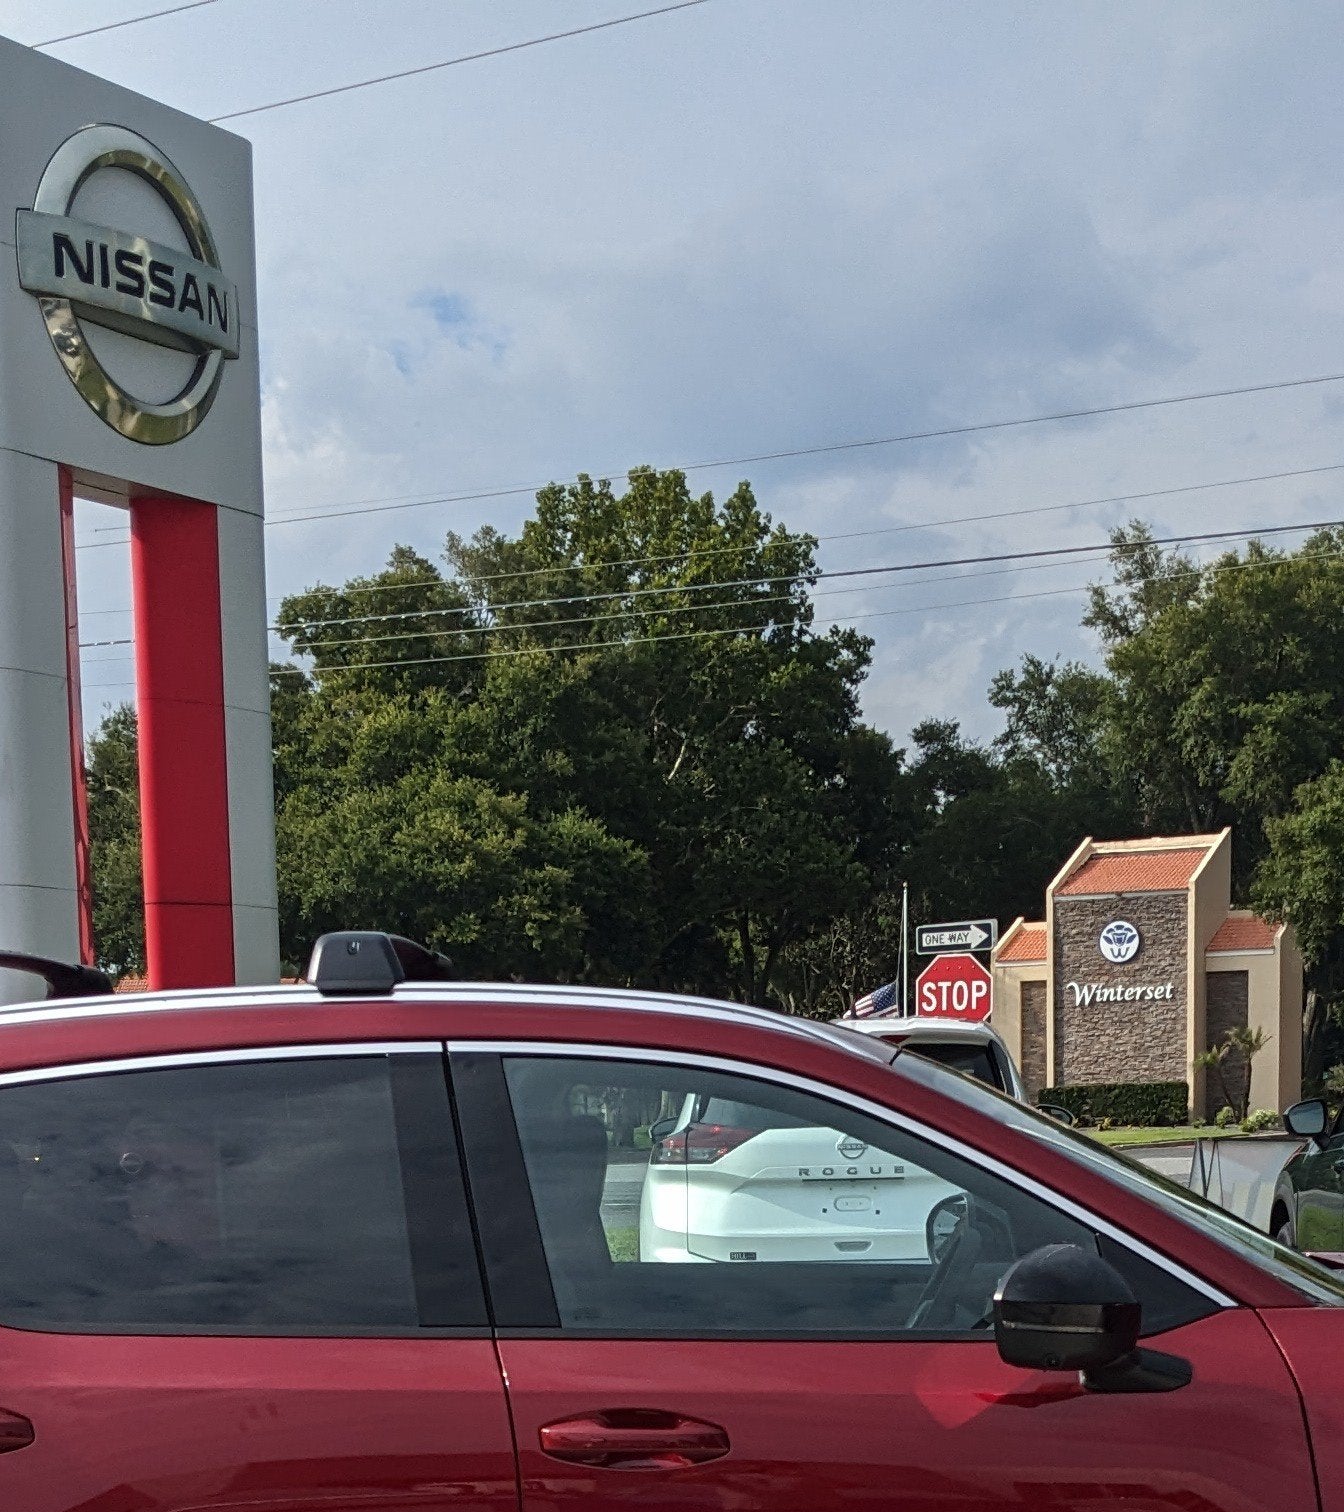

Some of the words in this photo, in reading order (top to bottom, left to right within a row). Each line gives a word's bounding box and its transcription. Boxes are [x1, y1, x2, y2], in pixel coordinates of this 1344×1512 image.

[52, 232, 230, 334] NISSAN
[924, 933, 945, 945] ONE
[948, 932, 970, 943] WAY
[921, 980, 988, 1012] STOP
[1066, 981, 1174, 1007] Winterset
[798, 1165, 905, 1177] ROGUE
